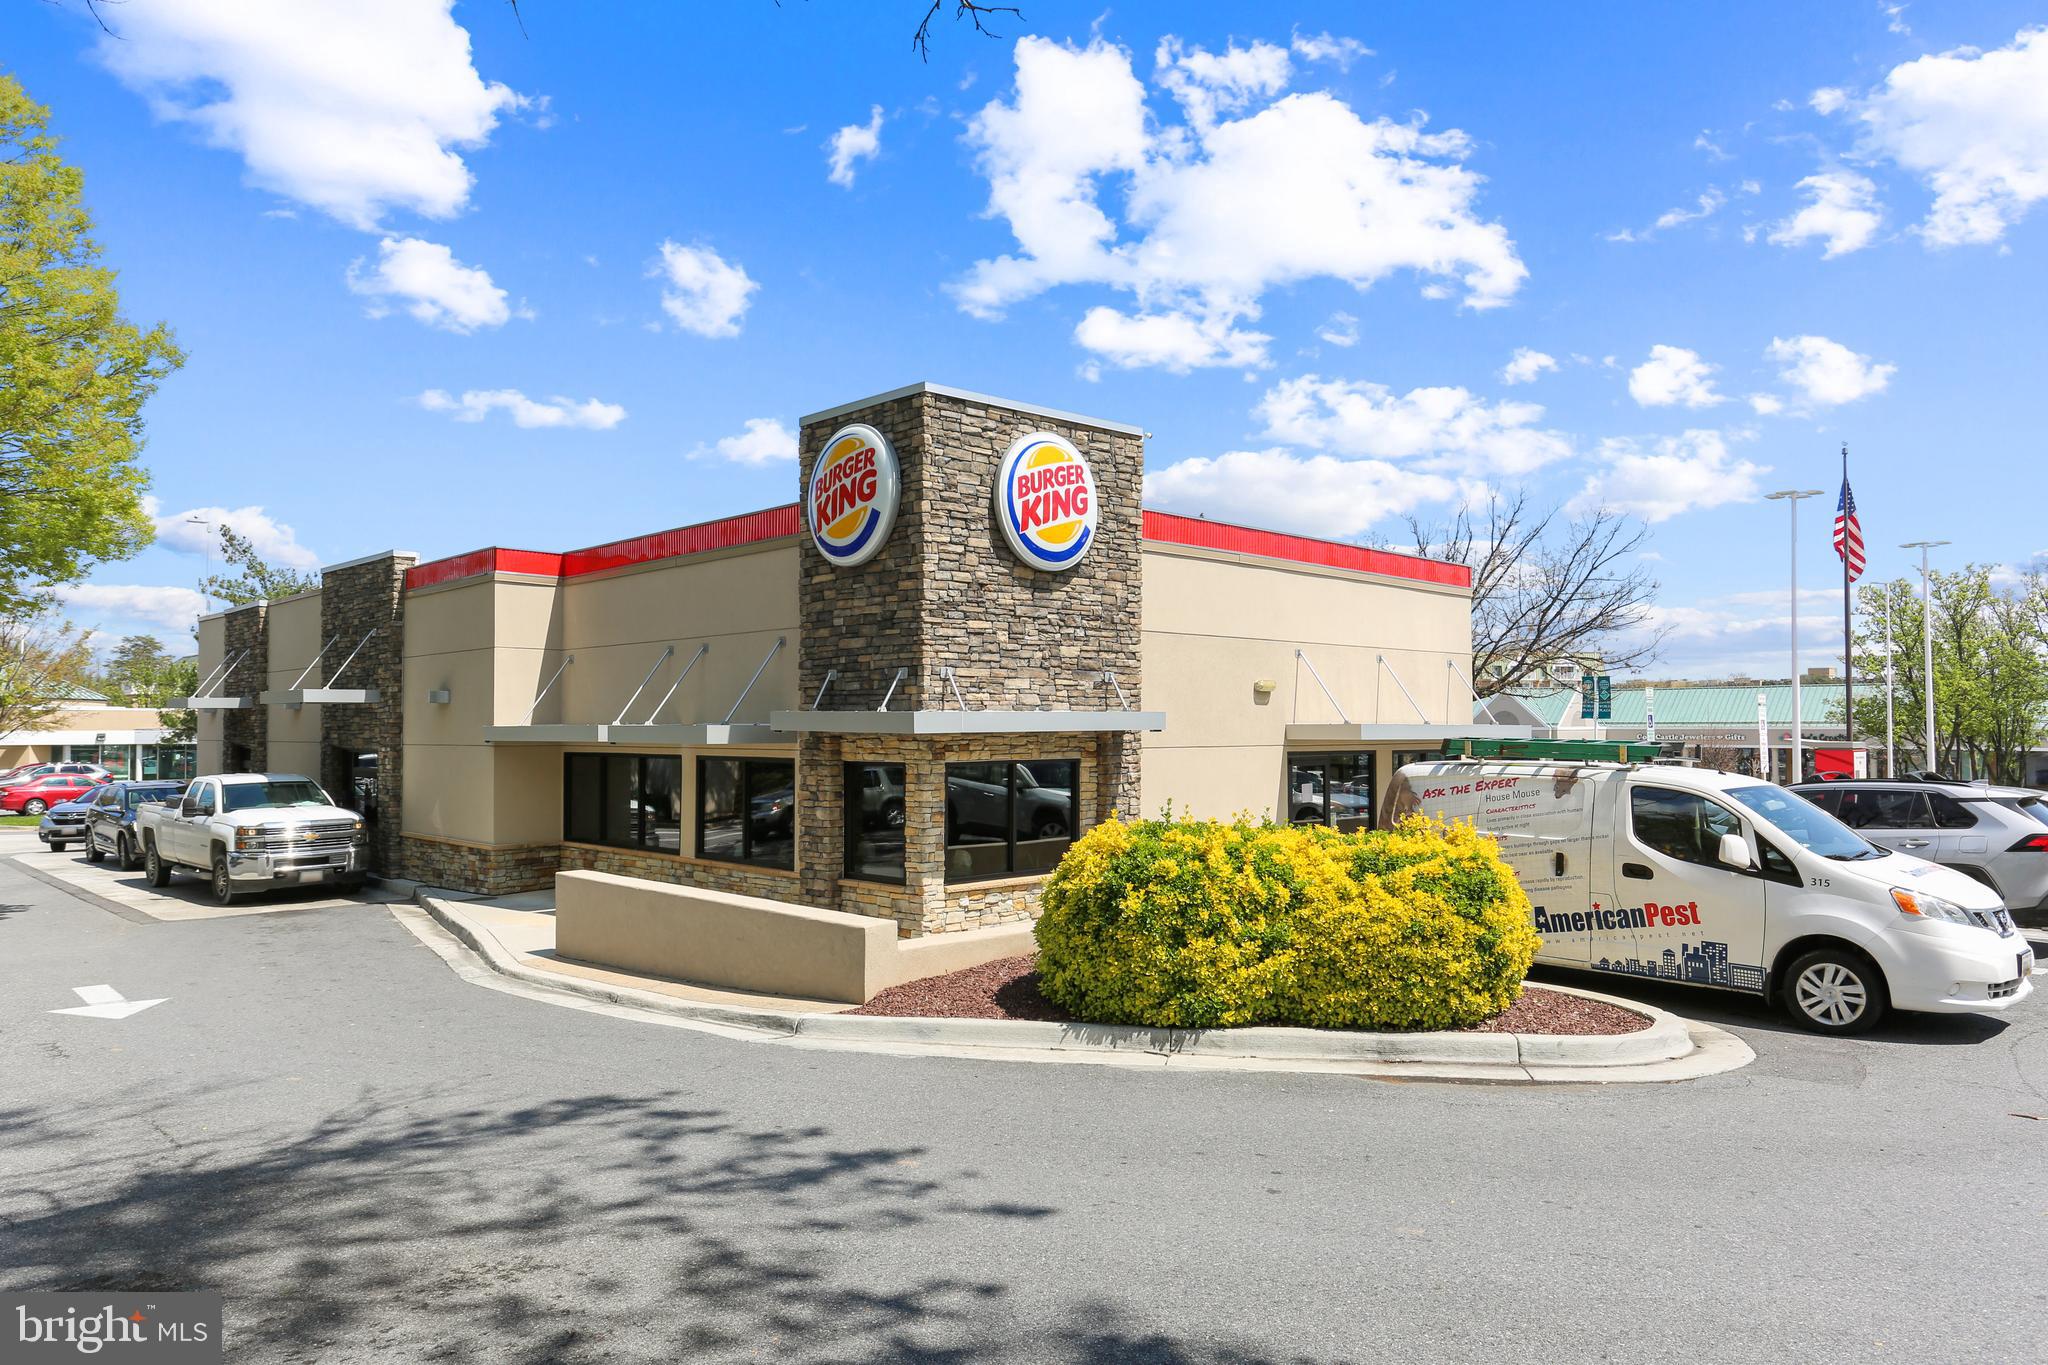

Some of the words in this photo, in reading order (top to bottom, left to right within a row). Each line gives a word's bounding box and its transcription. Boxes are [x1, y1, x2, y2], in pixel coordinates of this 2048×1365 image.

[815, 447, 876, 503] BURGER
[1017, 465, 1085, 499] BURGER
[816, 469, 877, 534] KING
[1020, 485, 1089, 532] KING
[1655, 733, 1679, 741] Castle
[1725, 733, 1745, 741] Gifts
[1423, 788, 1446, 800] ASK
[1450, 784, 1471, 796] THE
[1475, 777, 1520, 793] EXPERT
[1485, 792, 1511, 803] House
[1512, 788, 1541, 799] Mouse
[1485, 803, 1537, 815] CHARACTERISTICS
[1810, 877, 1831, 888] 315
[1534, 901, 1702, 934] AmericanPest
